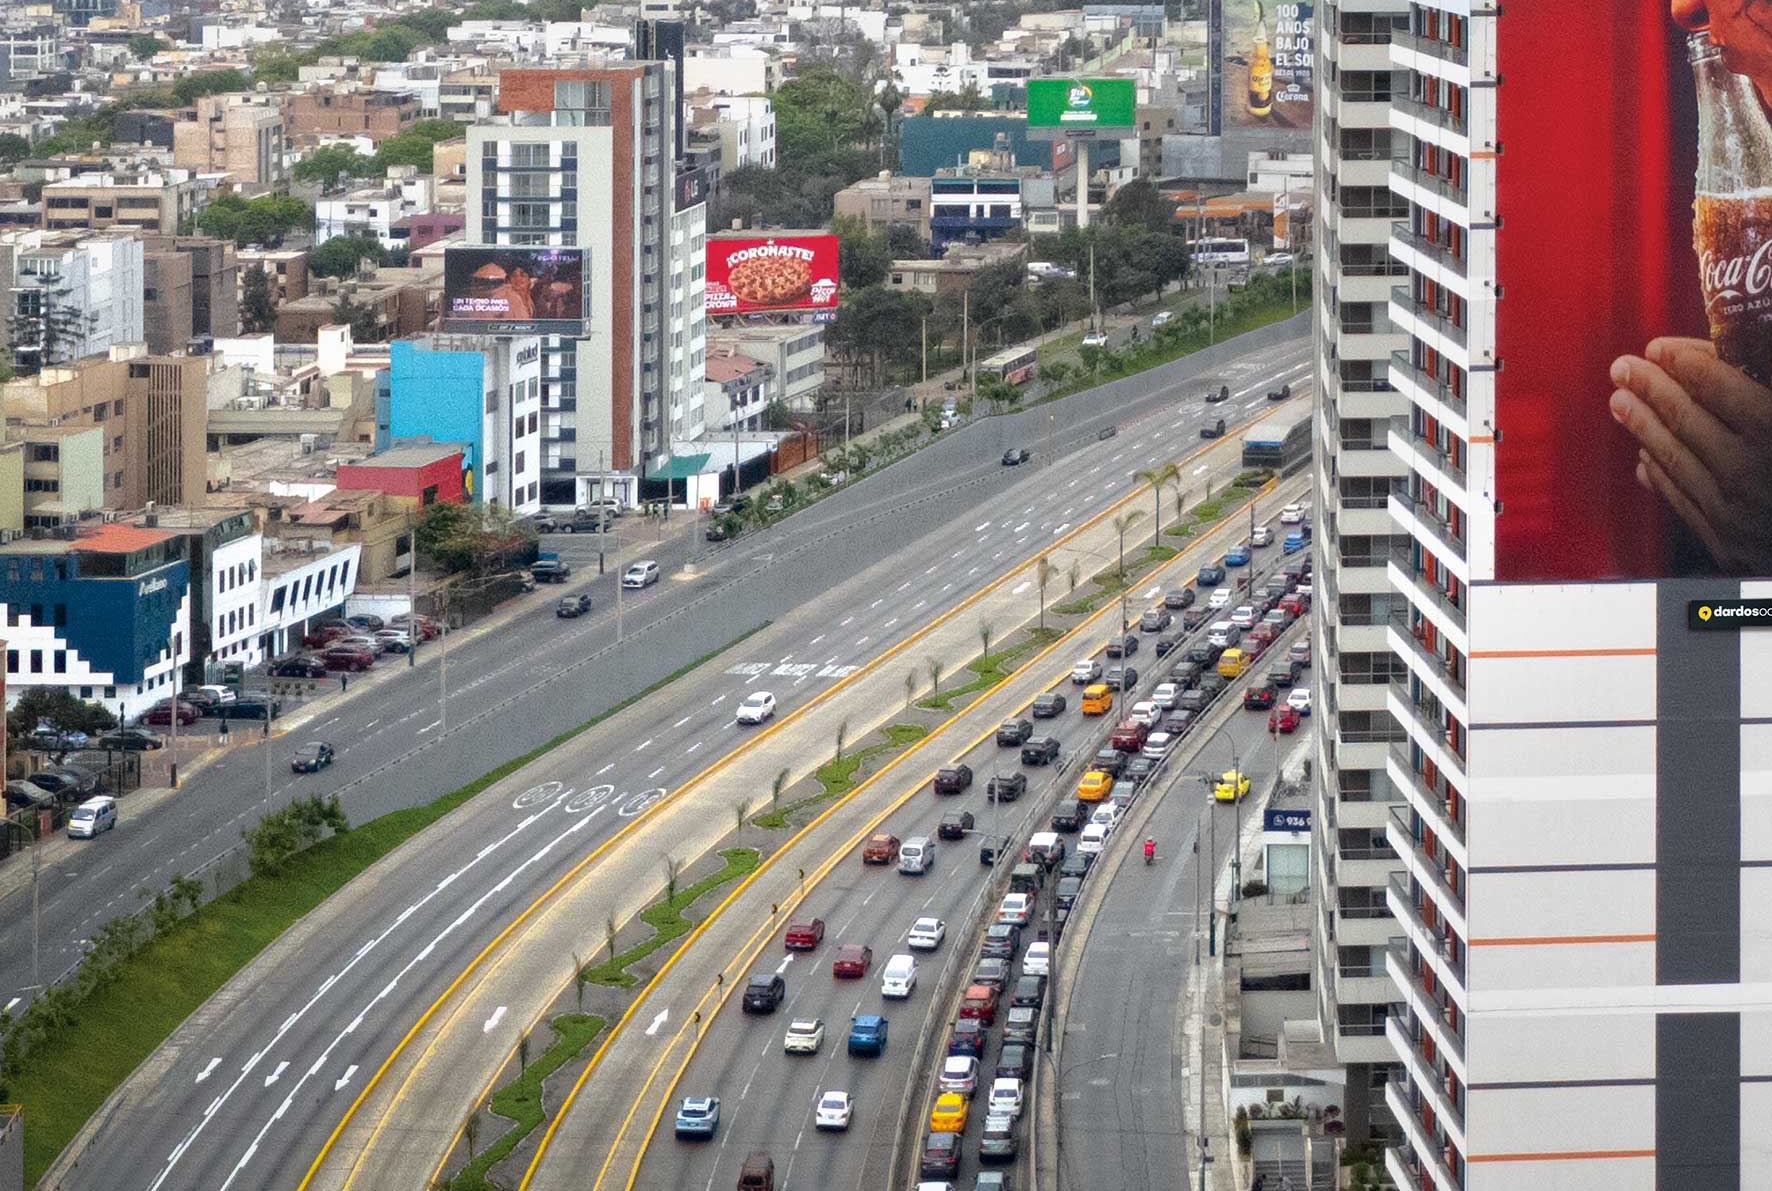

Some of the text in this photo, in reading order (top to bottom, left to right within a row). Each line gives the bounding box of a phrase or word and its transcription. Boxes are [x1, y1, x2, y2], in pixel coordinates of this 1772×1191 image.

[1276, 4, 1299, 18] 100
[1275, 37, 1310, 51] BAJO
[1275, 53, 1289, 66] EL
[1275, 92, 1310, 103] Corona
[1286, 816, 1305, 826] 936
